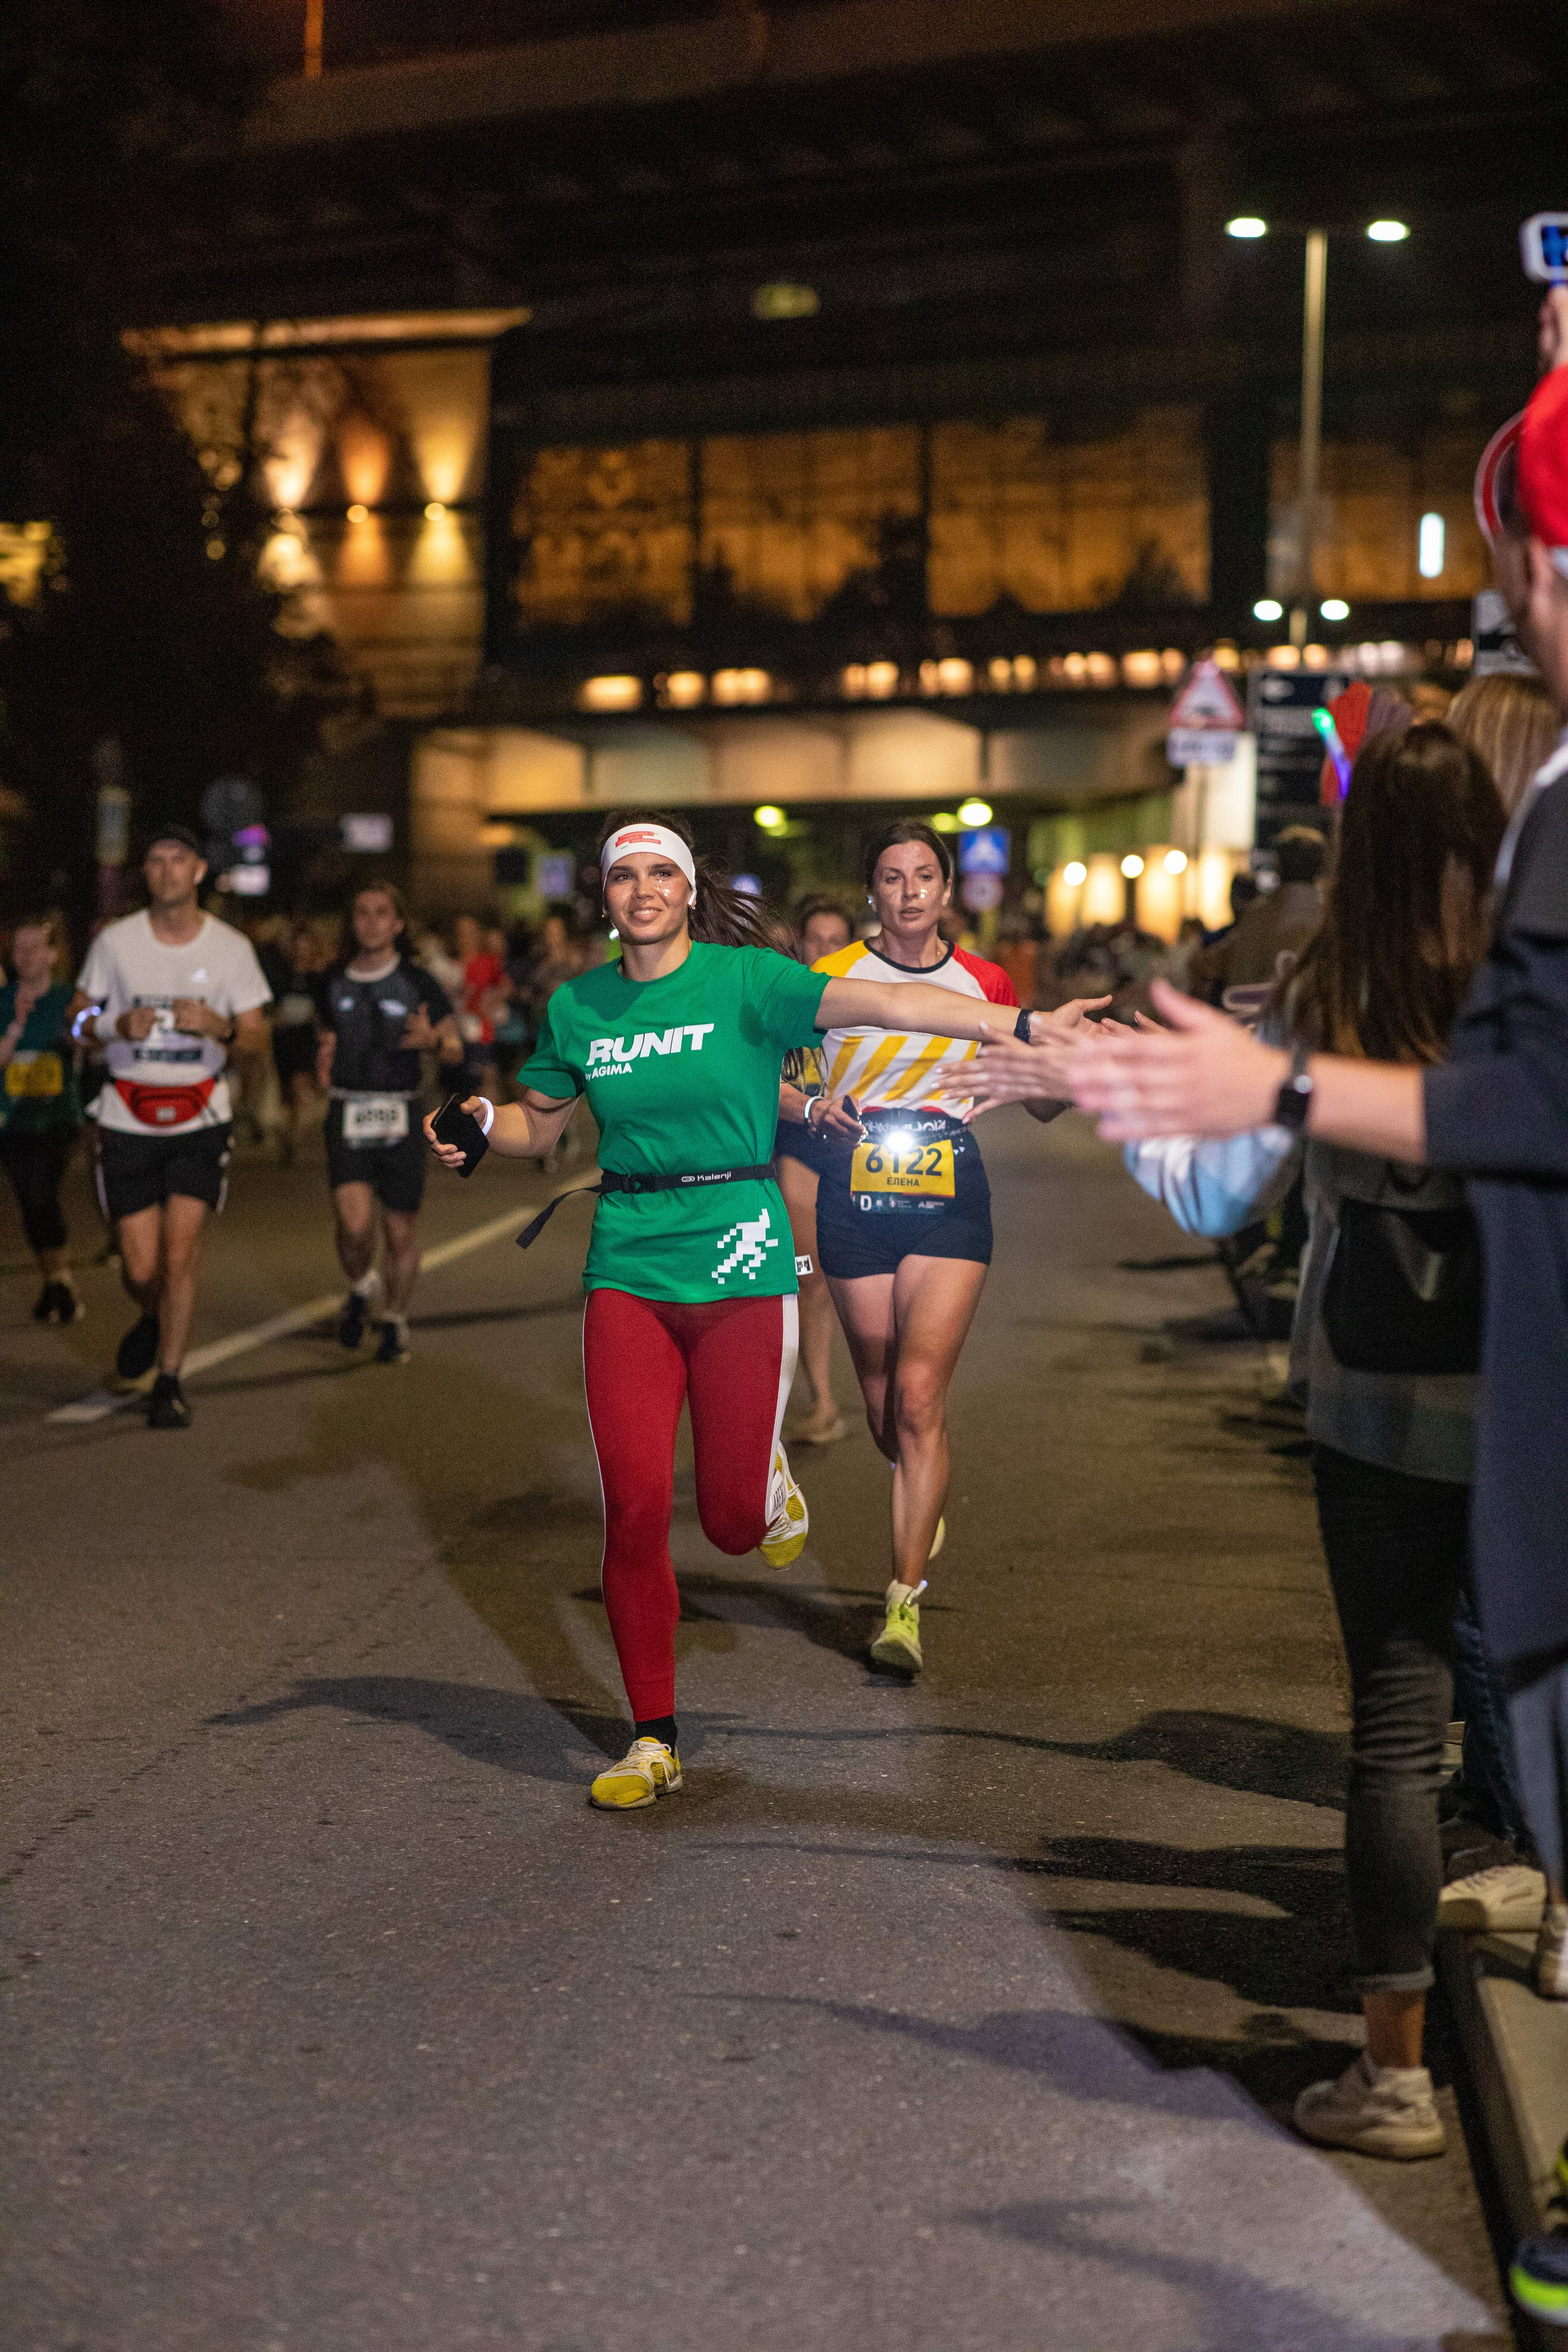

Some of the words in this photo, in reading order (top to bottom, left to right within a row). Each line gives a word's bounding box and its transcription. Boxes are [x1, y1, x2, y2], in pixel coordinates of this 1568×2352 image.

[586, 1023, 714, 1066] RUNIT
[592, 1063, 632, 1079] AGIMA
[865, 1146, 942, 1176] 6122
[698, 1171, 731, 1182] Kalenji
[887, 1177, 919, 1186] ЕЛЕНА
[860, 1195, 872, 1211] D
